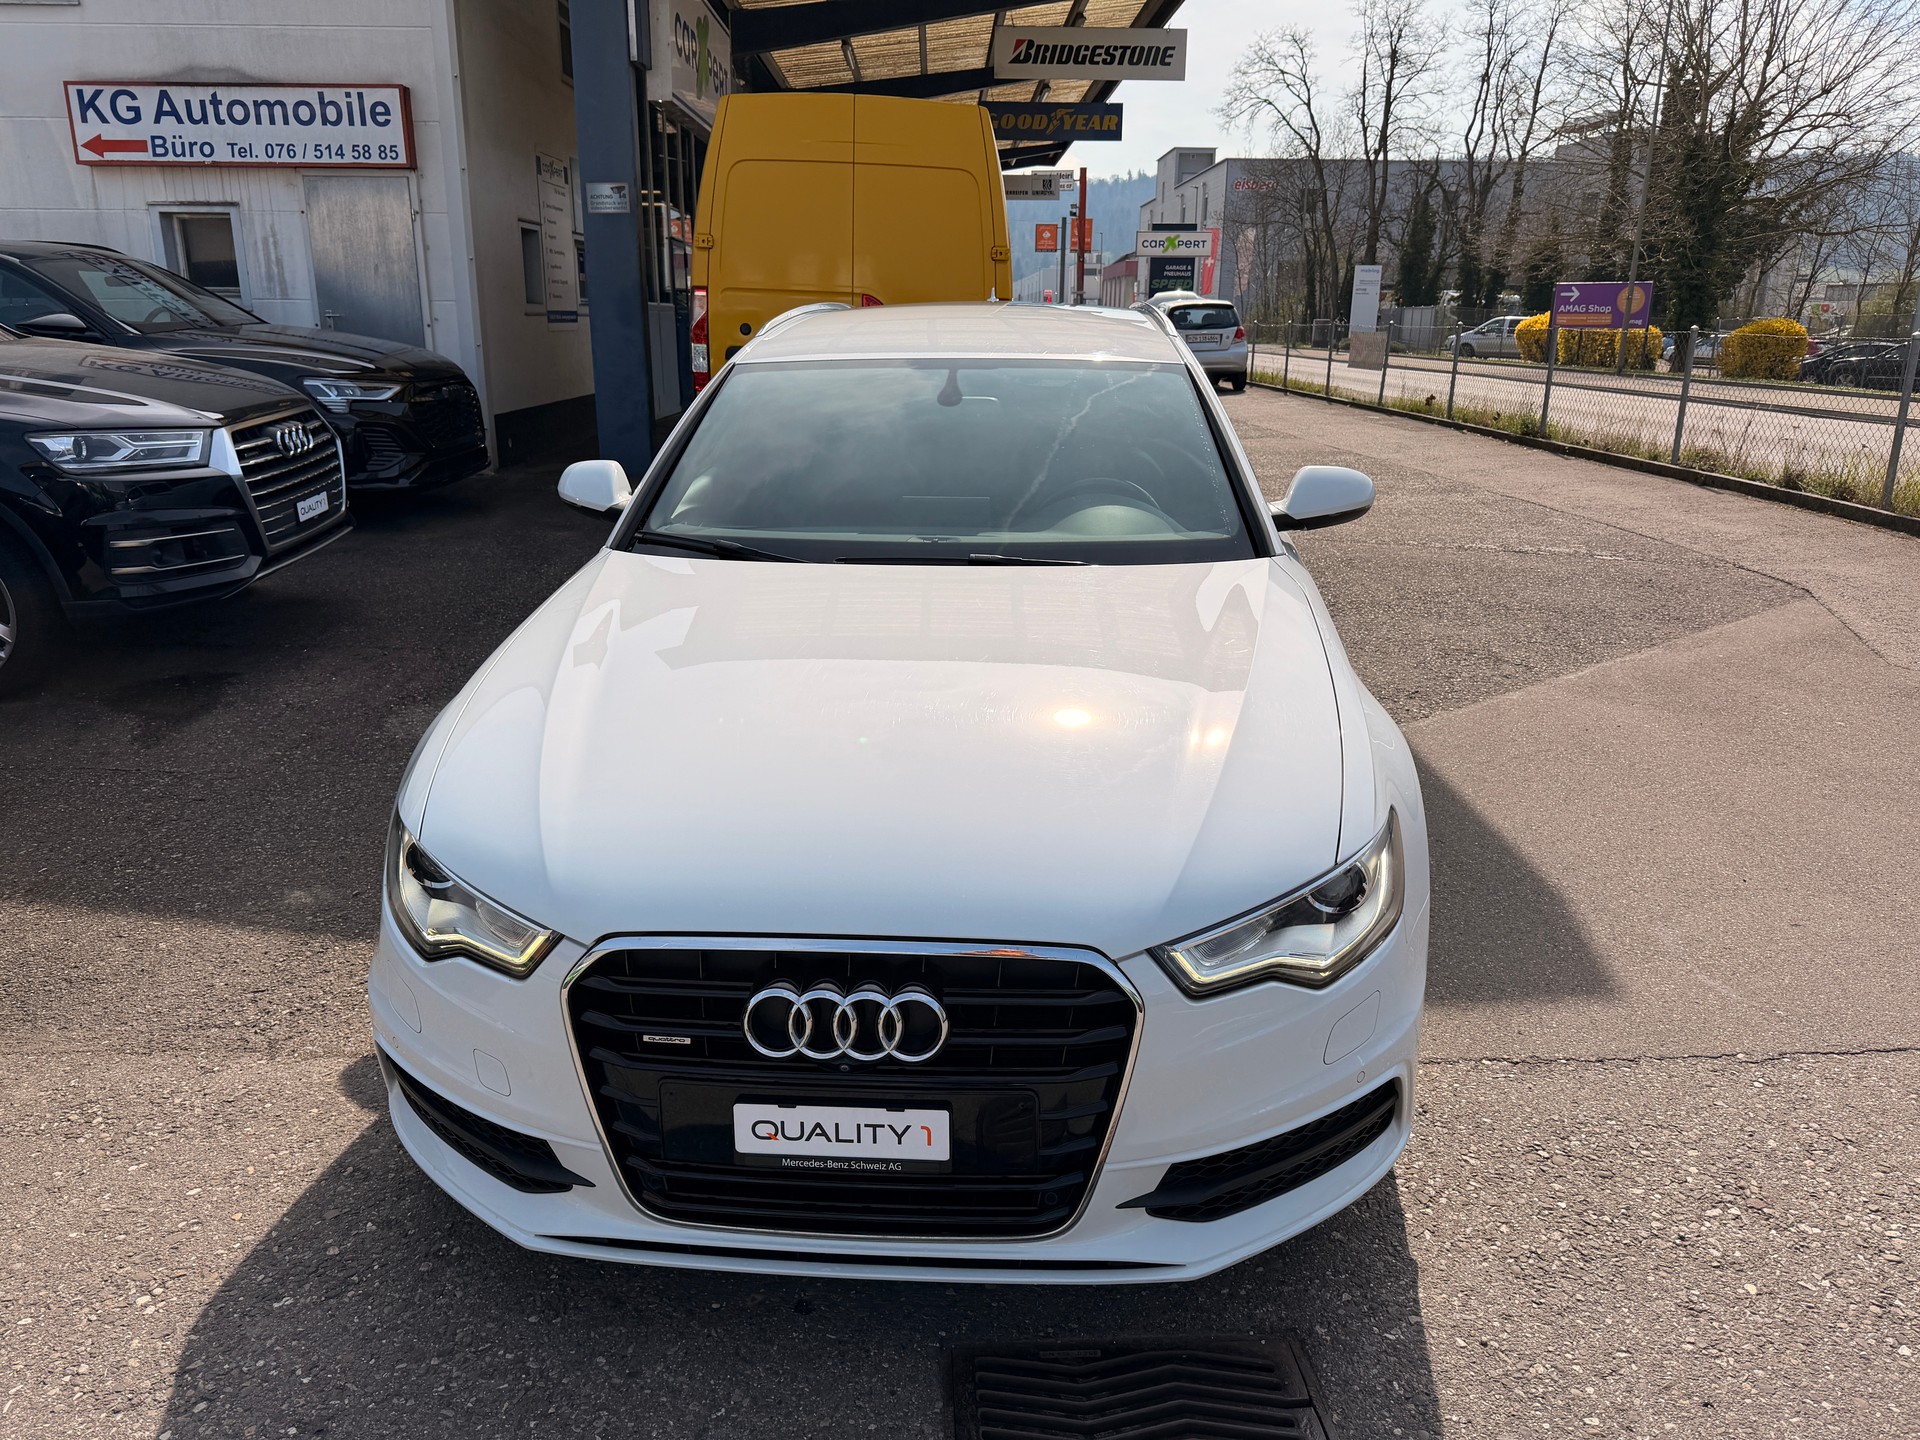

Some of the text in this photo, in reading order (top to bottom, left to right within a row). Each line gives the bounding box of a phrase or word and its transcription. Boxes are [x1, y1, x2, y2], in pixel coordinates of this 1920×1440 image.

[1008, 39, 1176, 67] BRIDGESTONE
[76, 88, 392, 128] KG Automobile
[150, 135, 399, 161] Büro Tel. 076 / 514 58 85
[1151, 279, 1193, 289] SPEED
[1558, 304, 1612, 314] AMAG Shop
[300, 500, 323, 516] QUALITY
[751, 1119, 932, 1147] QUALITY 1
[782, 1158, 902, 1171] Mercedes-Benz Schweiz AG
